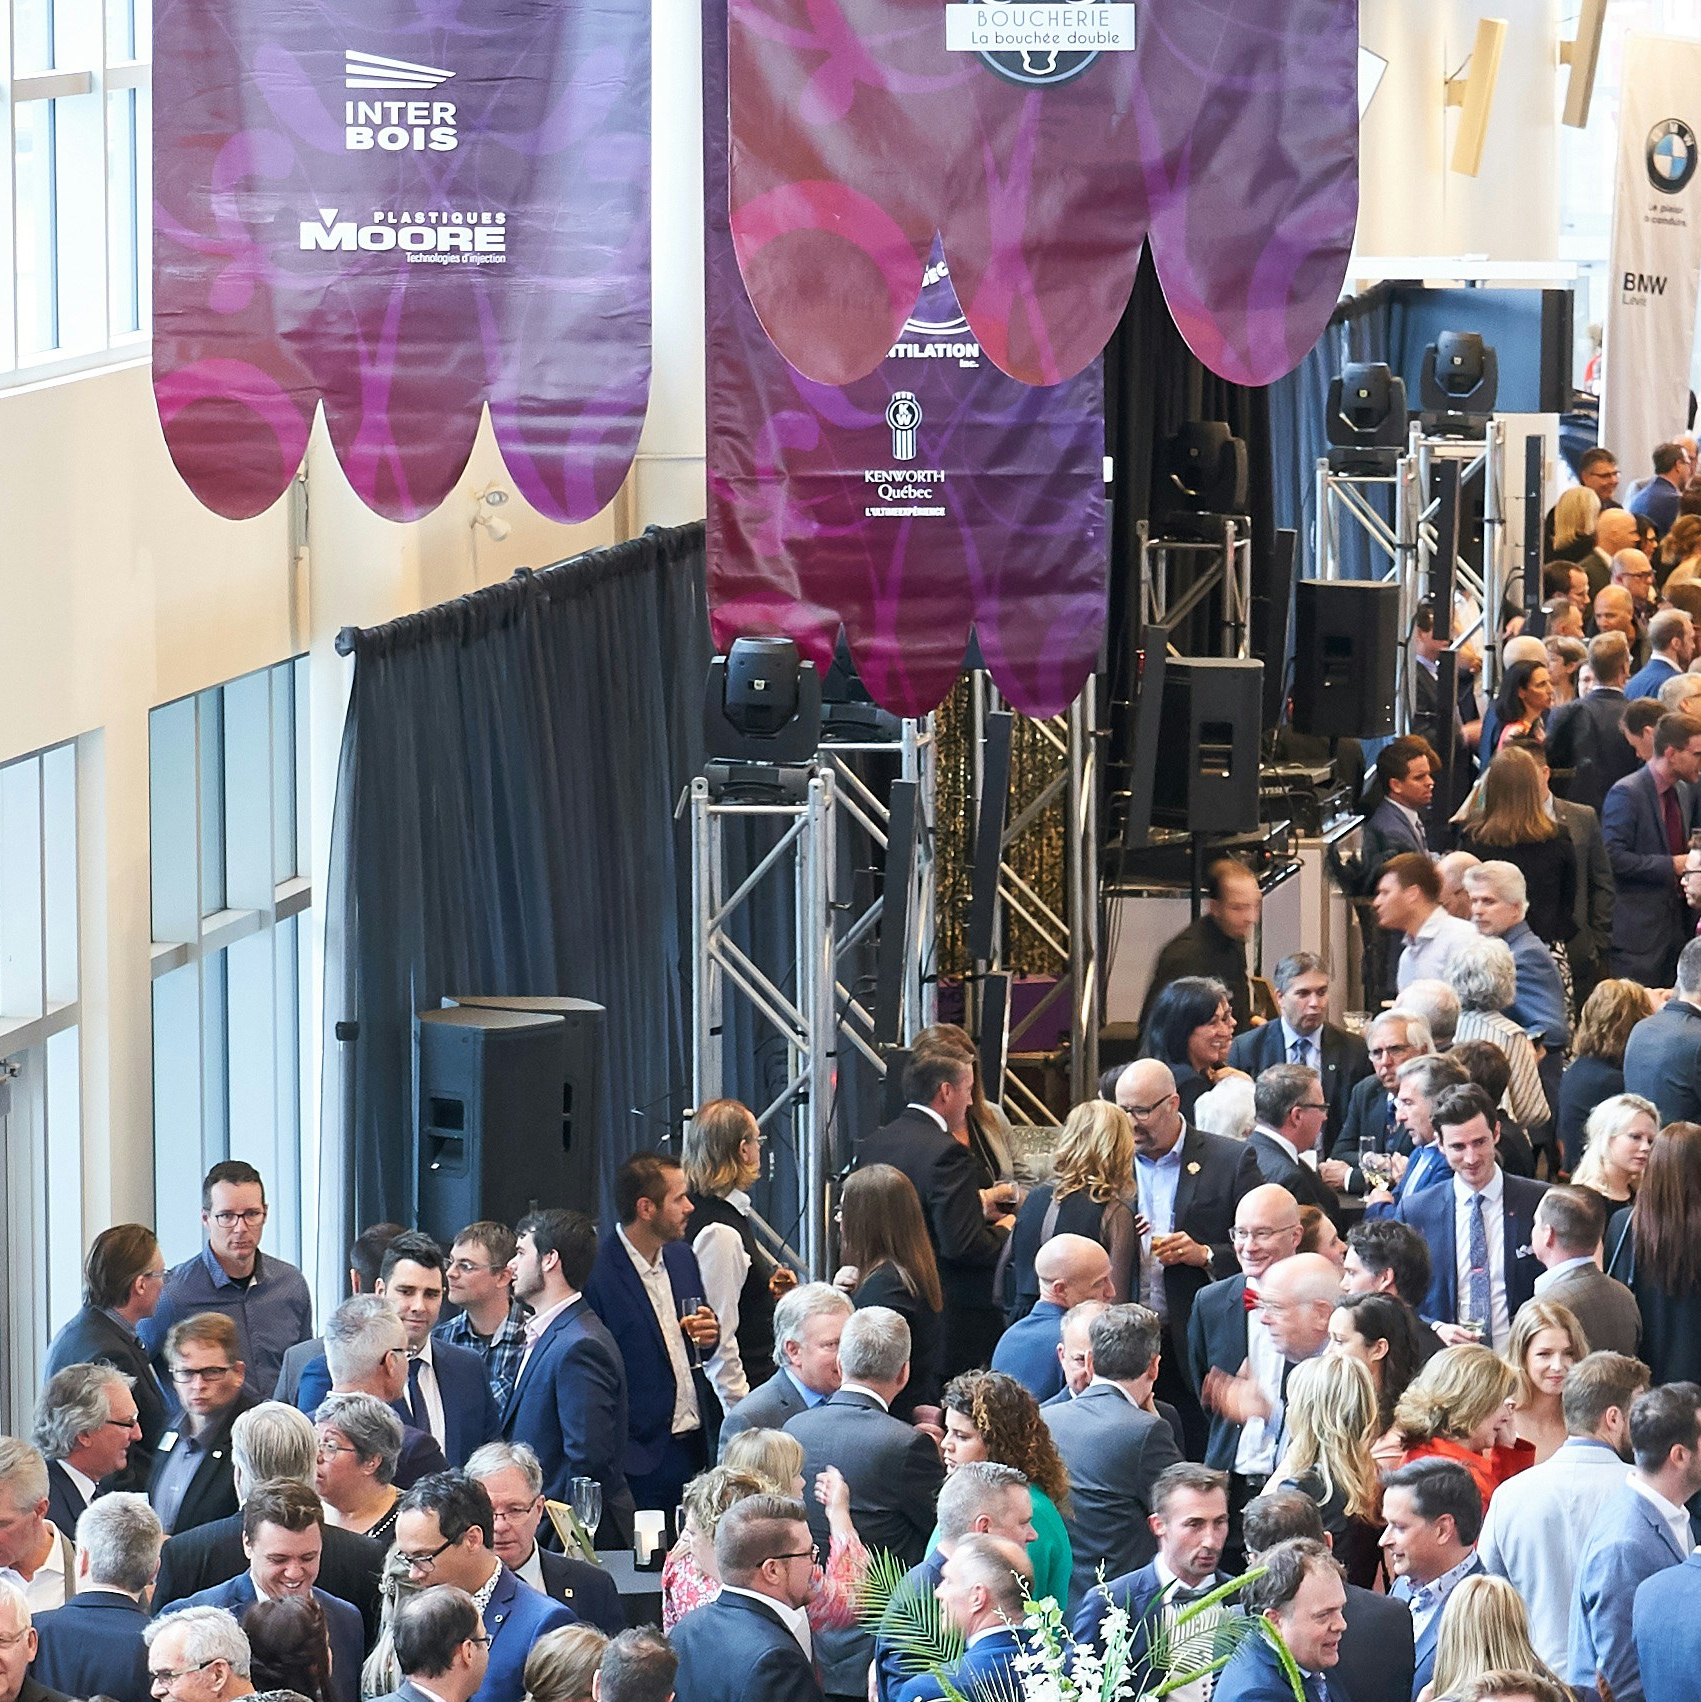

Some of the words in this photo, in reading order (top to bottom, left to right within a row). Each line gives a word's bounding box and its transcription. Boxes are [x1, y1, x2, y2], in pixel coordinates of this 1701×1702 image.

[977, 10, 1110, 27] BOUCHERIE
[971, 31, 989, 44] La
[995, 31, 1061, 44] bouchée
[1067, 31, 1121, 44] double
[345, 100, 457, 125] INTER
[345, 126, 459, 152] BOIS
[373, 211, 506, 225] PLASTIQUES
[300, 221, 506, 252] MOORE
[405, 251, 460, 265] Technologies
[461, 252, 507, 265] d'injection
[1623, 272, 1668, 296] BMW
[864, 469, 945, 483] KENWORTH
[877, 483, 933, 501] Québec
